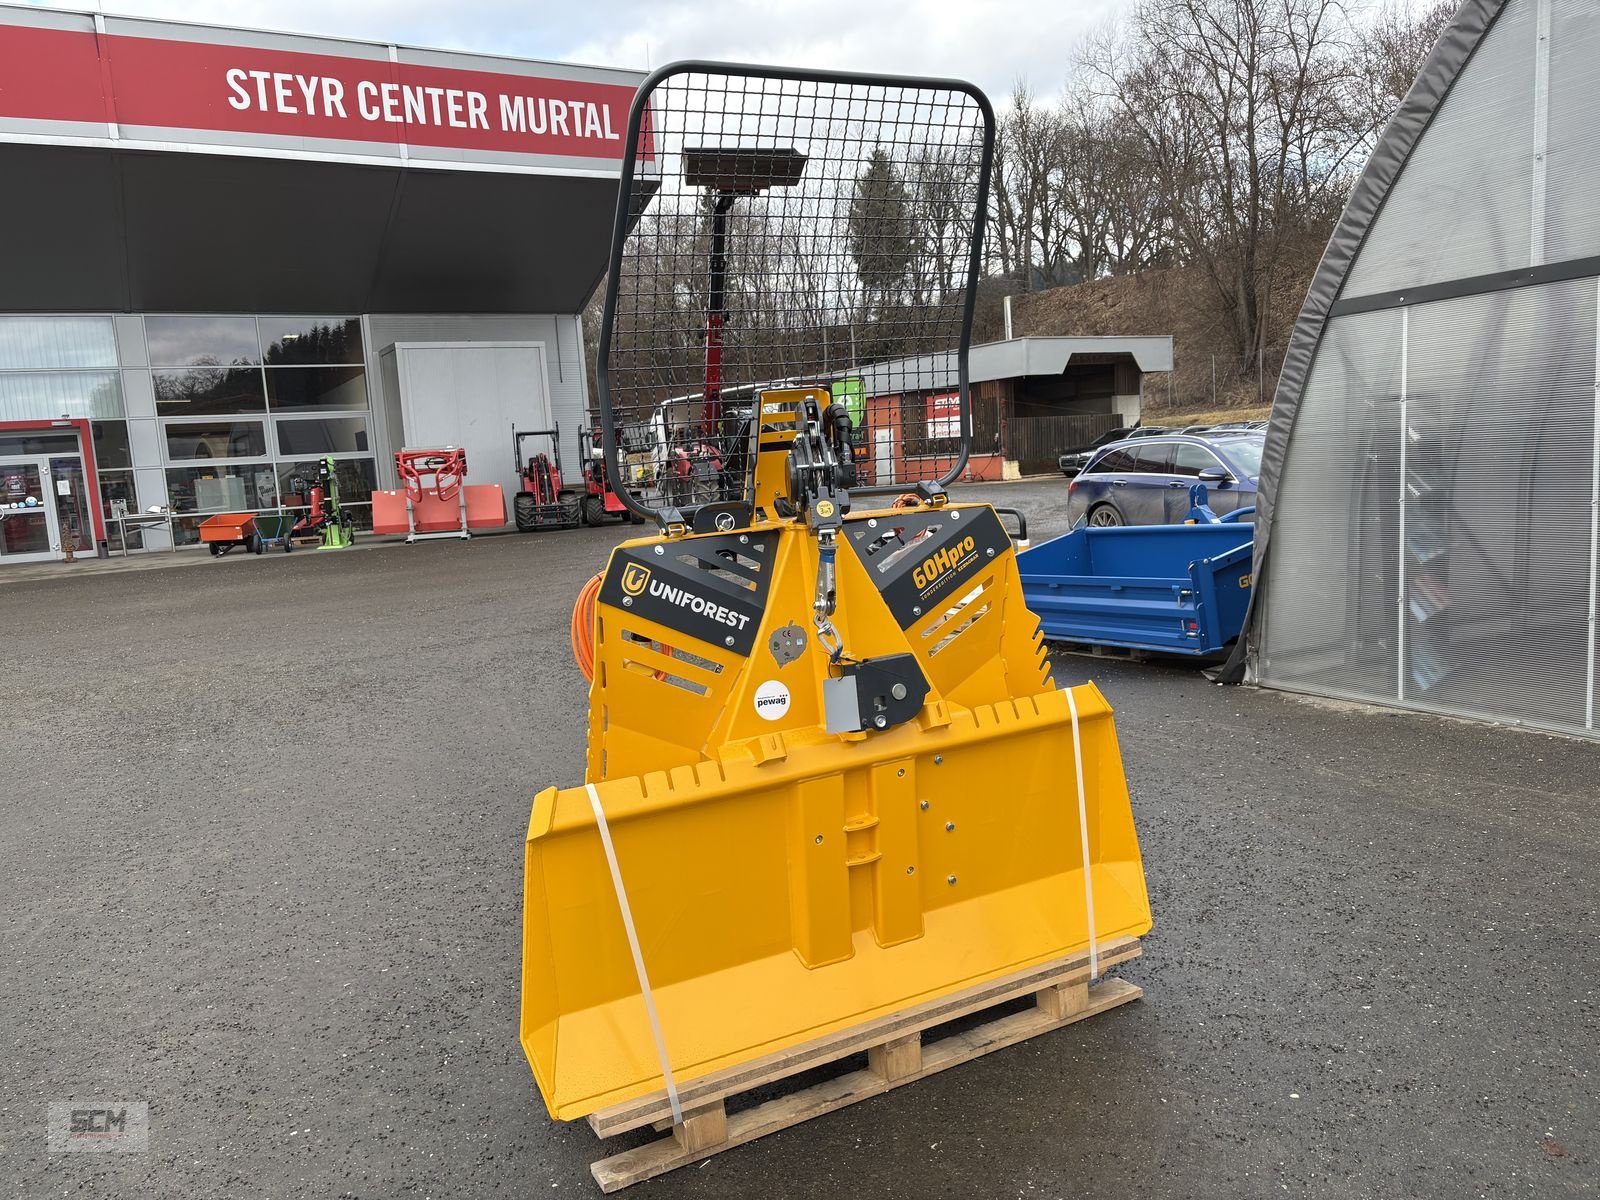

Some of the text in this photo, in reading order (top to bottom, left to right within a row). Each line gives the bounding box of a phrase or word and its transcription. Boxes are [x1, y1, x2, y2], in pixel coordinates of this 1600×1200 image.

[226, 68, 620, 139] STEYR CENTER MURTAL
[912, 536, 975, 589] 60Hpro
[649, 579, 750, 630] UNIFOREST
[757, 697, 786, 708] pewag
